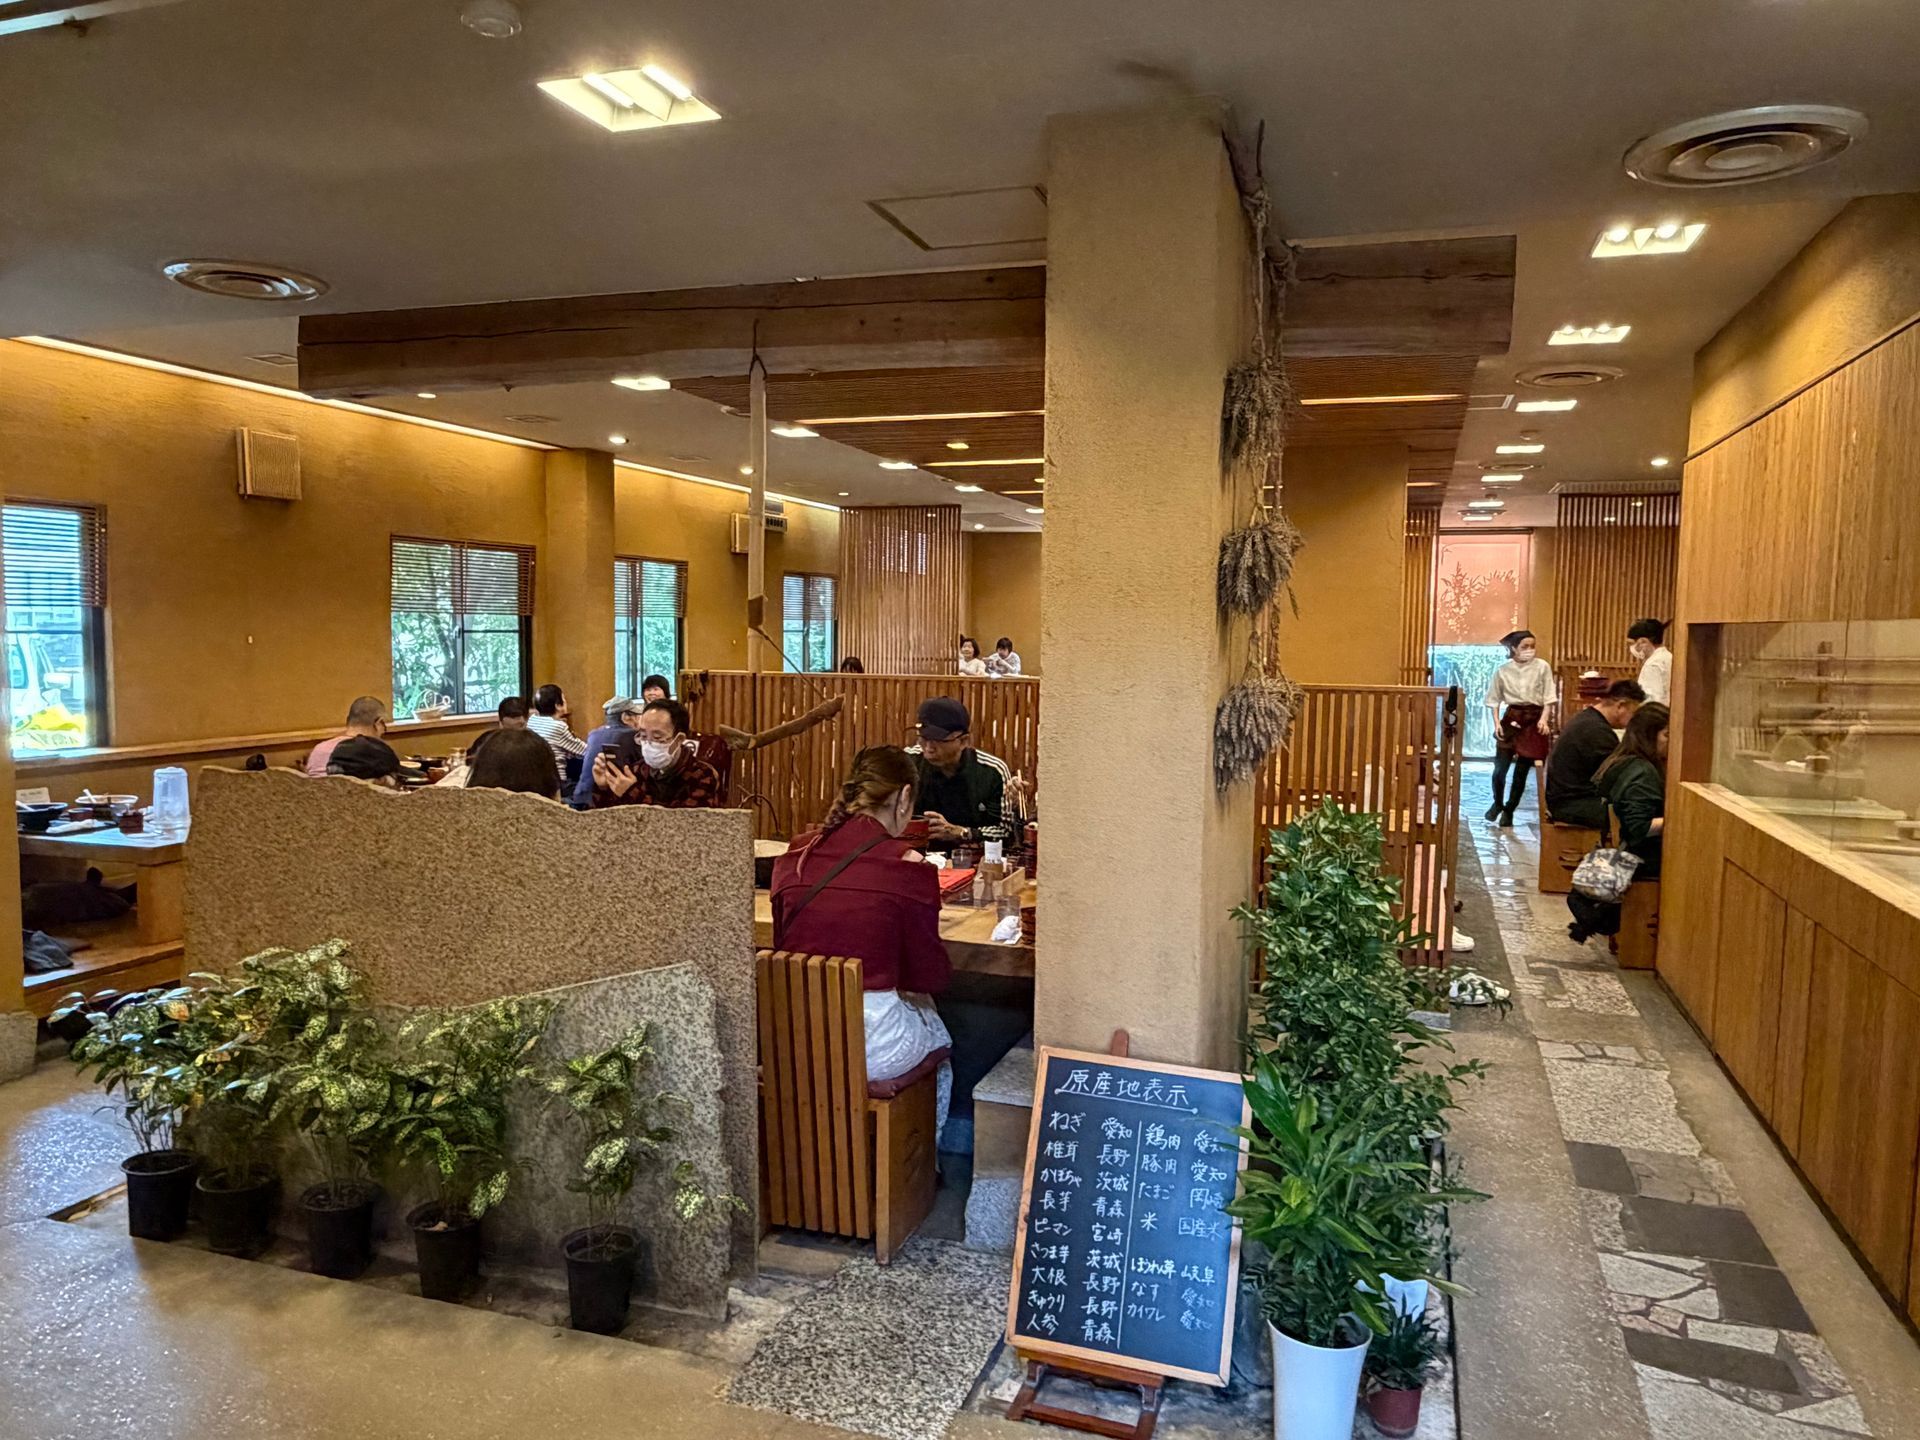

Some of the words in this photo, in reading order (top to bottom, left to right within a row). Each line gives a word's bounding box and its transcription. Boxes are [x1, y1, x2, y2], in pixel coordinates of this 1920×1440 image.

[1061, 1069, 1189, 1106] 原産地表示
[1048, 1110, 1087, 1133] ねぎ
[1100, 1117, 1133, 1140] 愛知
[1145, 1122, 1181, 1151] 鶏肉
[1043, 1140, 1079, 1162] 椎茸
[1096, 1144, 1131, 1167] 長野
[1141, 1153, 1178, 1176] 豚肉
[1190, 1159, 1228, 1183] 愛知
[1040, 1167, 1082, 1188] かぼちゃ
[1095, 1170, 1131, 1192] 茨城
[1138, 1181, 1176, 1200] たまご
[1039, 1189, 1071, 1213] 長芋
[1092, 1195, 1125, 1218] 青森
[1034, 1217, 1073, 1237] ピーマン
[1091, 1222, 1125, 1246] 宮崎
[1140, 1211, 1158, 1232] 米
[1178, 1216, 1225, 1241] 国産米
[1030, 1241, 1070, 1264] さつま芋
[1085, 1248, 1125, 1274] 茨城
[1131, 1257, 1177, 1280] ほうれん草
[1180, 1264, 1216, 1287] 岐阜
[1031, 1265, 1069, 1287] 大根
[1082, 1271, 1121, 1295] 長野
[1131, 1281, 1160, 1303] なす
[1180, 1287, 1216, 1309] 愛知
[1026, 1289, 1066, 1313] きゅうり
[1080, 1296, 1119, 1320] 長野
[1127, 1303, 1167, 1322] カイワレ
[1179, 1309, 1213, 1331] 愛知
[1026, 1313, 1060, 1337] 人参
[1080, 1318, 1116, 1345] 青森
